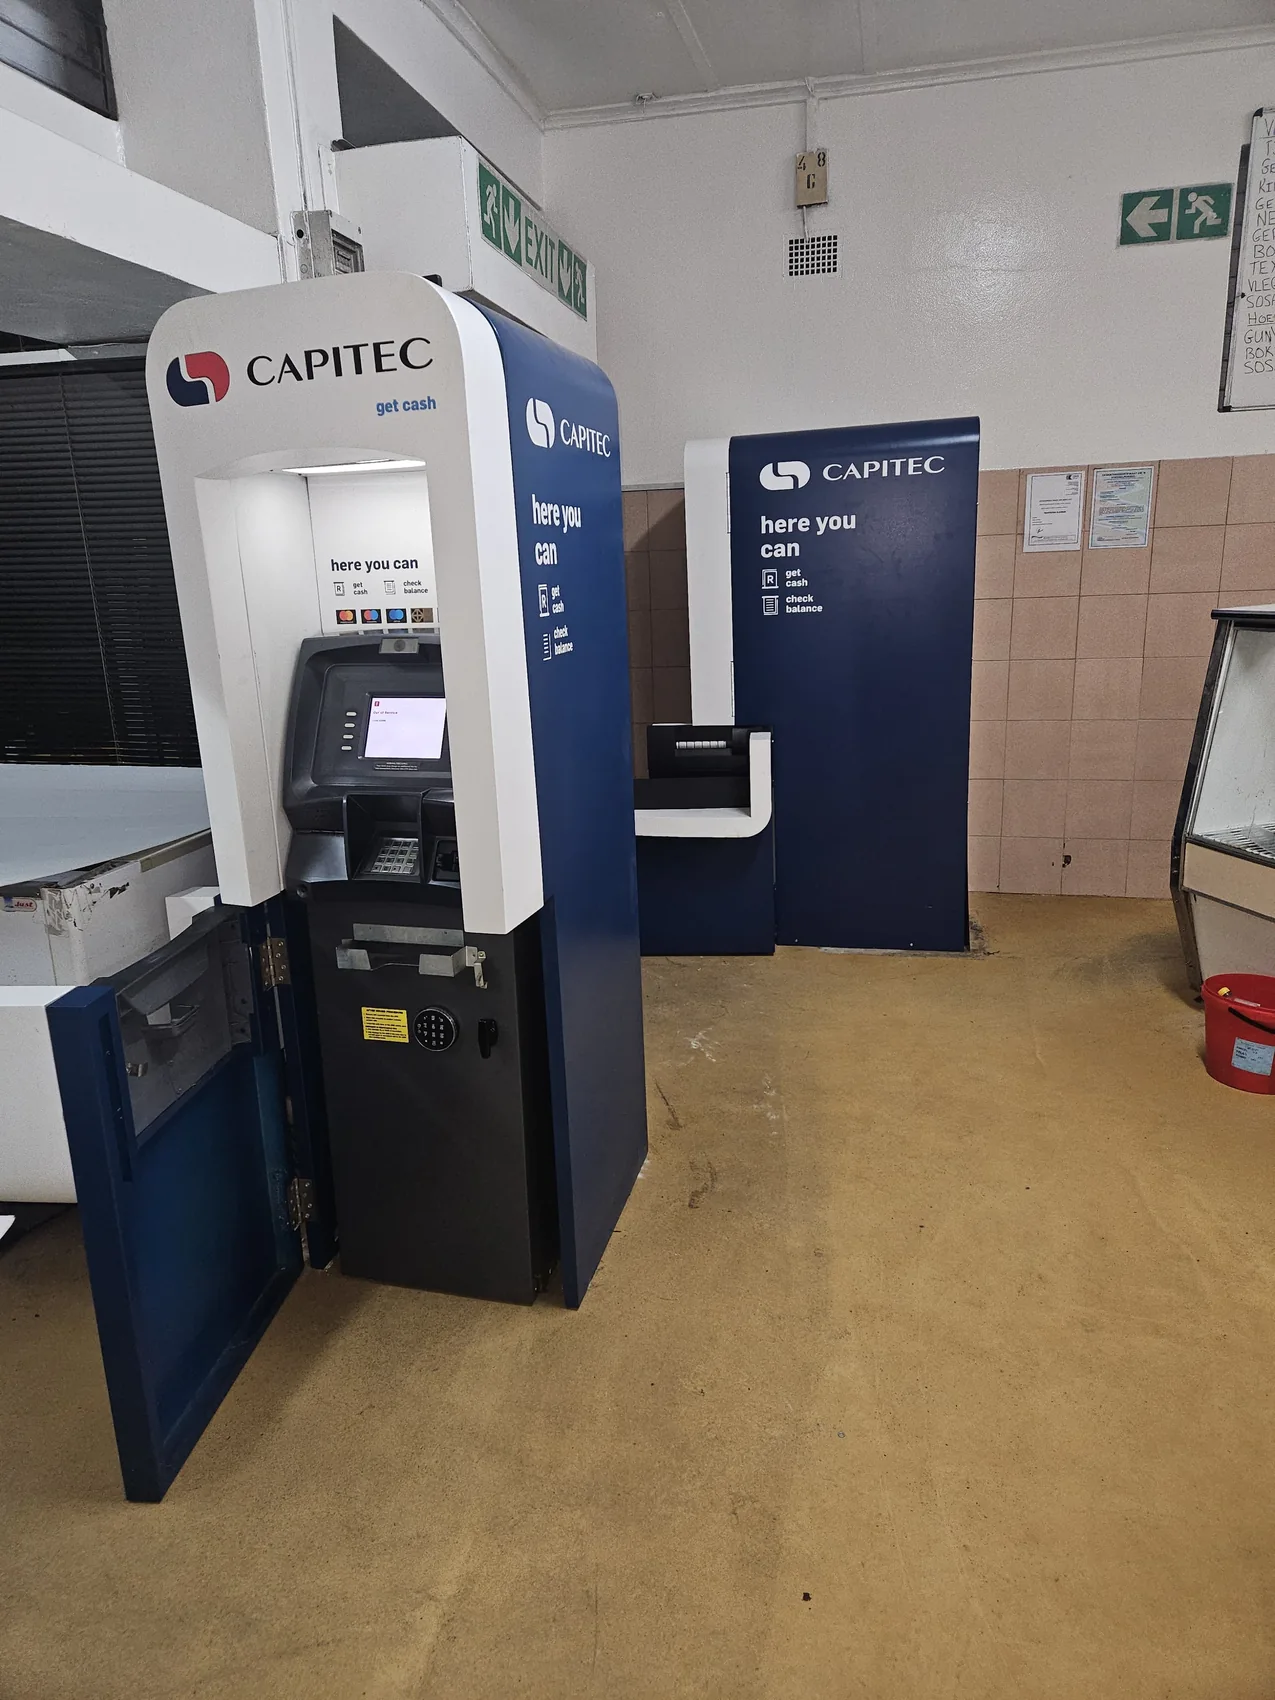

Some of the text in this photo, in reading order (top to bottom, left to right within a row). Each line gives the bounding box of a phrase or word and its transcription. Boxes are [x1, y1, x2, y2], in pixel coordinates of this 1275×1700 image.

[1264, 118, 1275, 136] V
[817, 151, 826, 167] 8
[1258, 178, 1275, 194] KI
[524, 215, 556, 284] EXIT
[246, 337, 434, 386] CAPITEC
[376, 395, 437, 417] get cash
[560, 418, 611, 458] CAPITEC
[822, 455, 946, 481] CAPITEC
[531, 493, 582, 534] here you
[760, 514, 856, 536] here you
[534, 541, 558, 566] can
[760, 541, 800, 558] can
[331, 559, 418, 573] here you can
[785, 568, 801, 578] get
[785, 578, 808, 587] cash
[551, 584, 561, 600] get
[785, 594, 814, 603] check
[552, 600, 565, 614] cash
[785, 603, 823, 614] balance
[553, 624, 569, 640] check
[554, 641, 574, 656] balance
